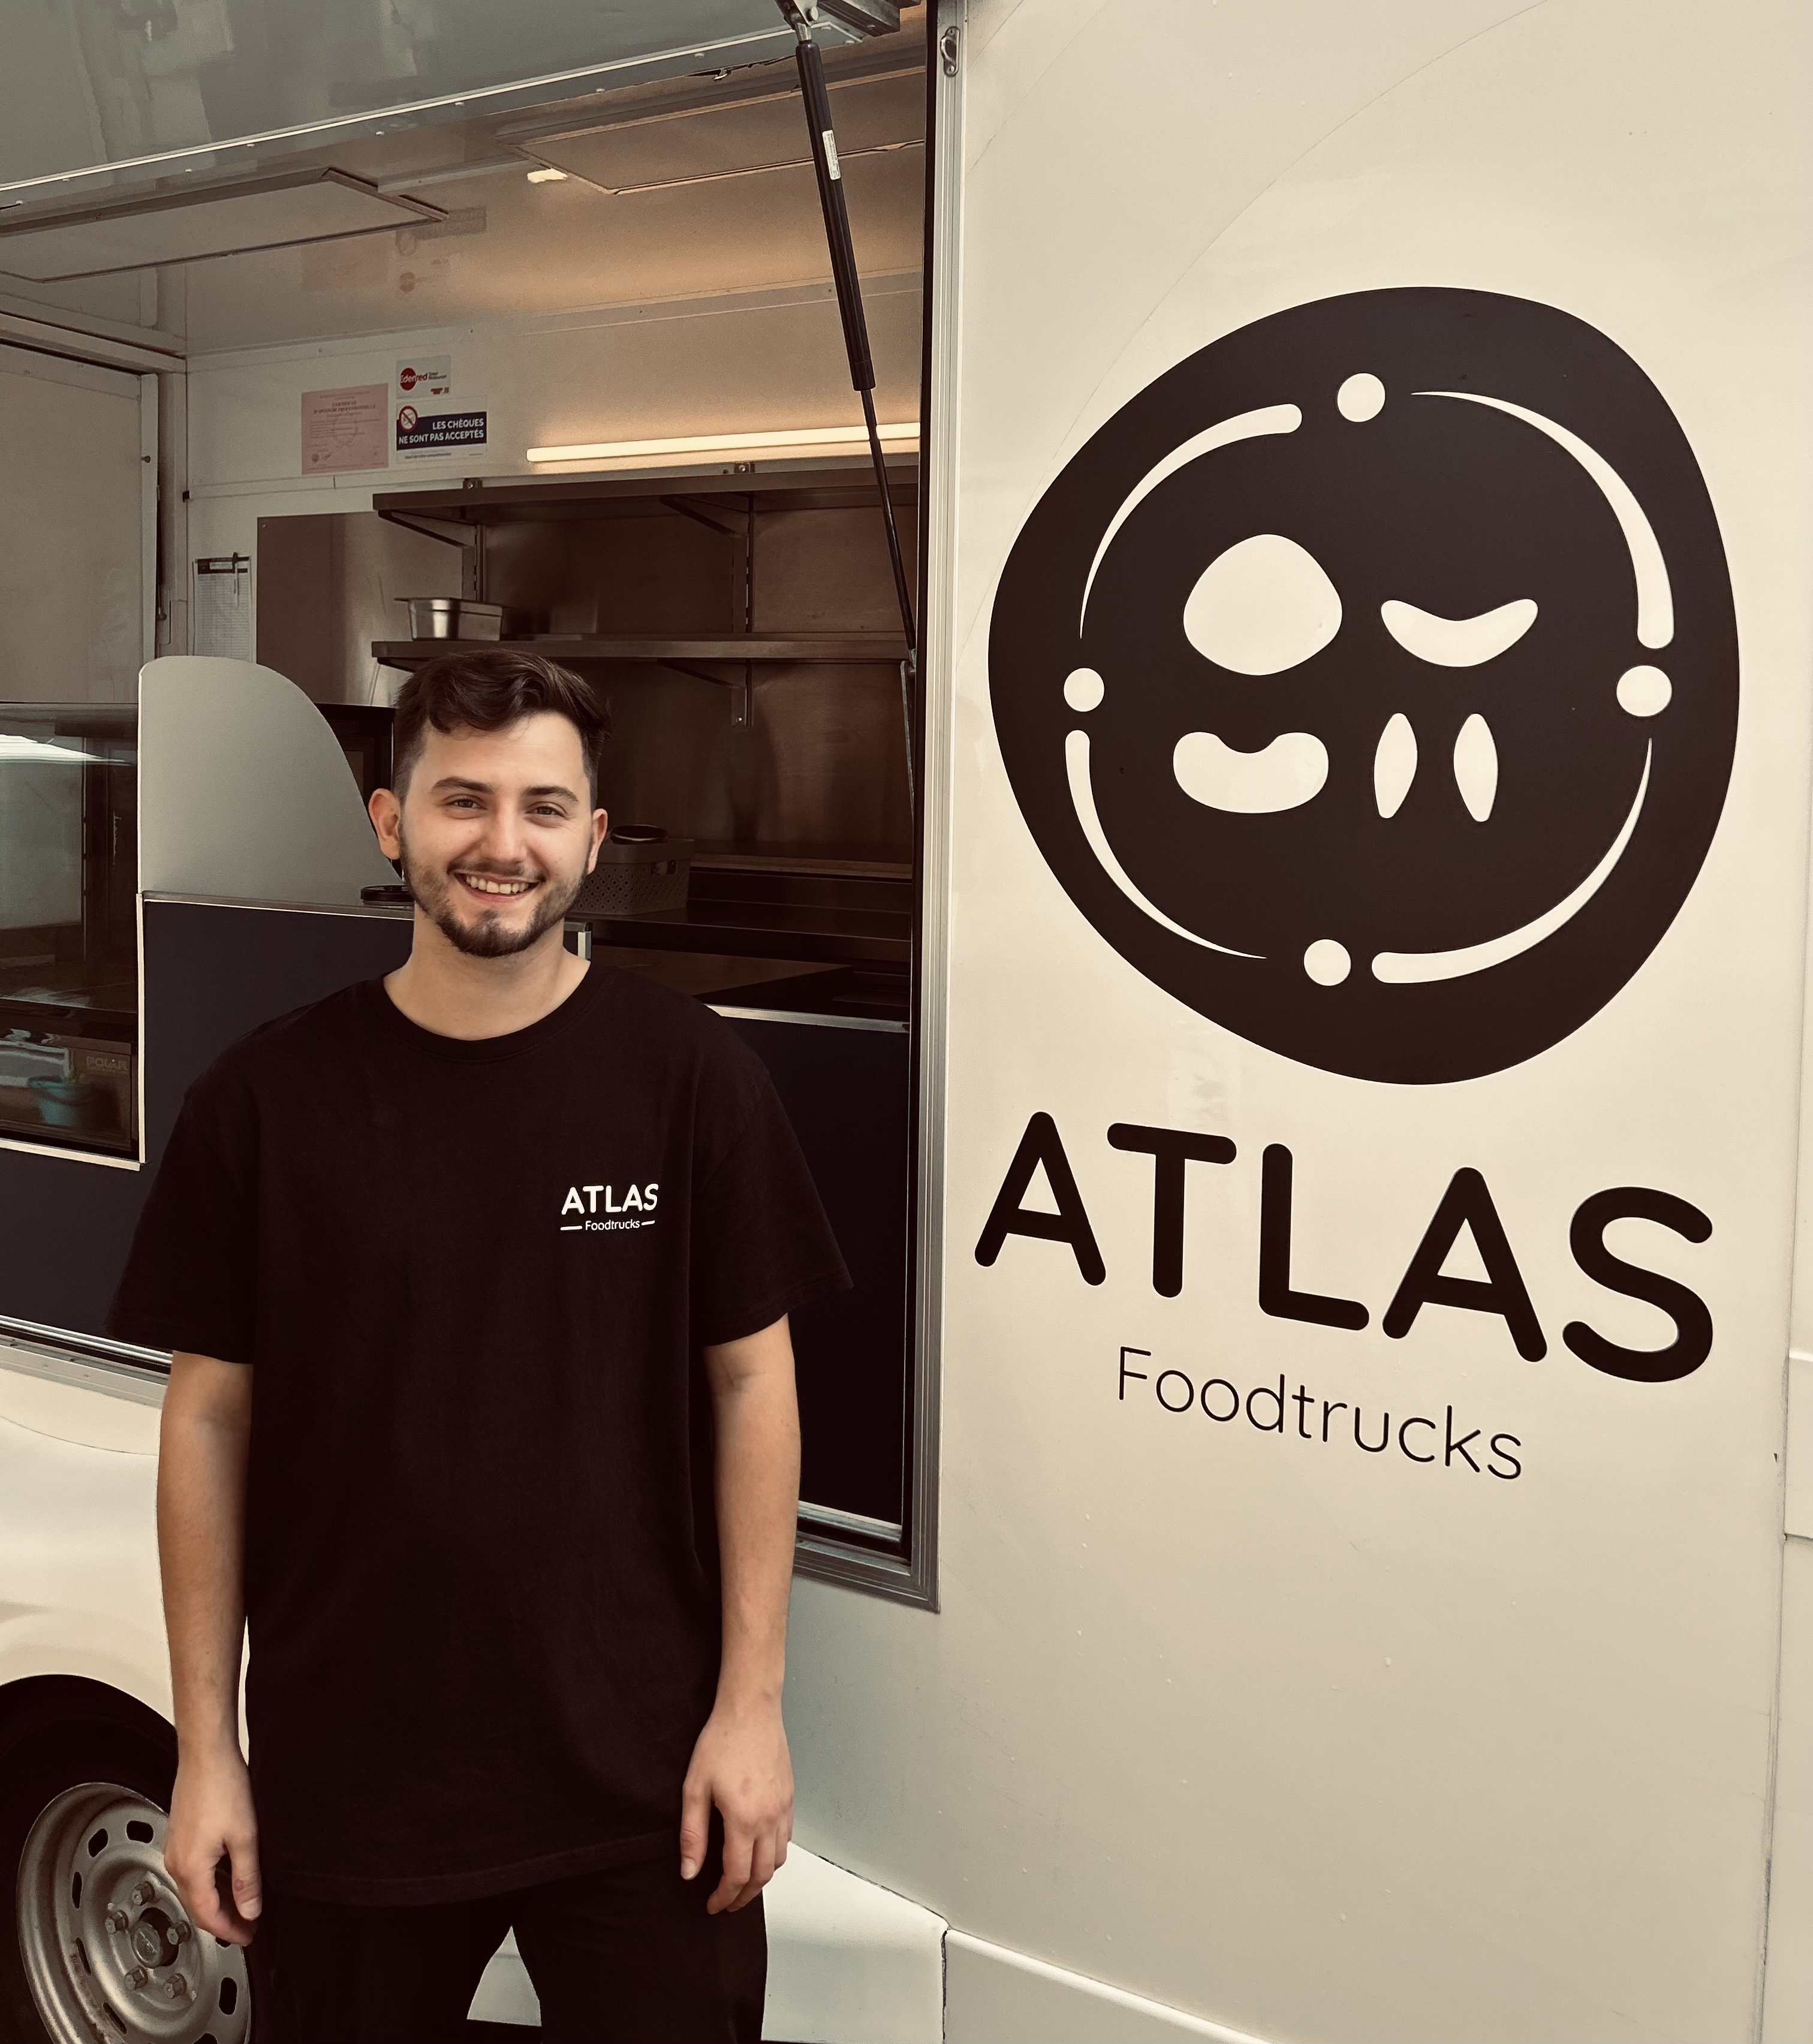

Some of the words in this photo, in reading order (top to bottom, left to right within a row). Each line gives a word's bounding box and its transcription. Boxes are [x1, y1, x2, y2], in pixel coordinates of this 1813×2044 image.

[400, 372, 428, 384] Edenred
[432, 421, 446, 430] LES
[399, 435, 408, 444] NE
[409, 433, 429, 444] SONT
[430, 432, 444, 442] PAS
[445, 428, 484, 441] ACCEPTÉS
[561, 1183, 659, 1215] ATLAS
[585, 1219, 640, 1231] Foodtrucks
[975, 1112, 1713, 1382] ATLAS
[1119, 1346, 1521, 1480] Foodtrucks
